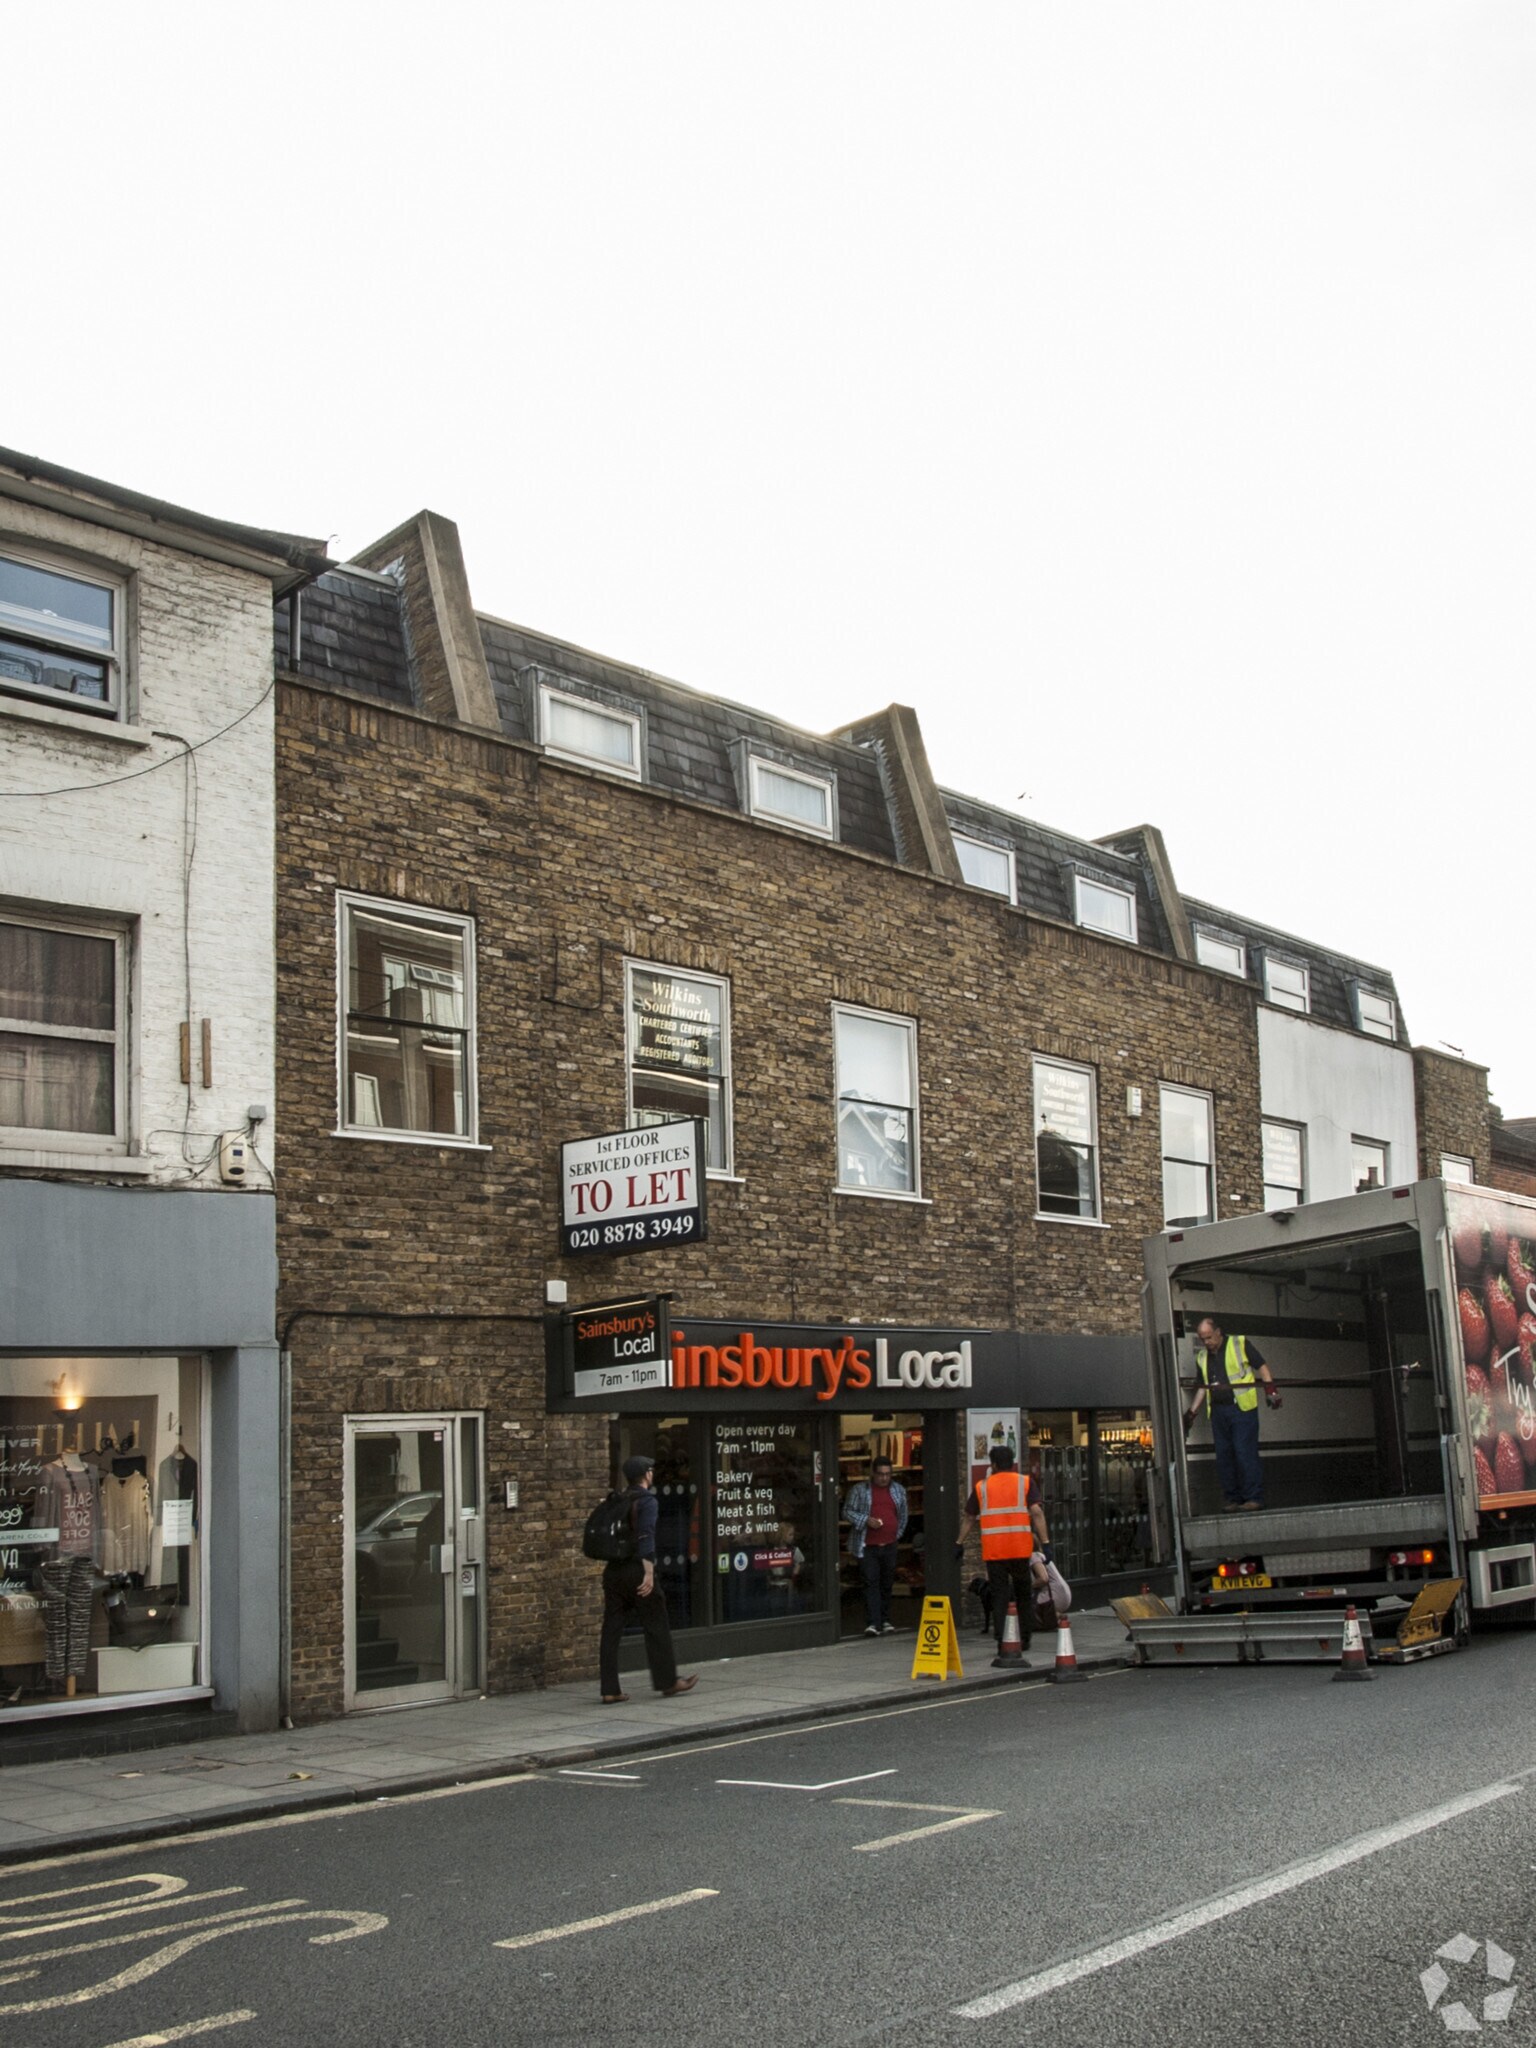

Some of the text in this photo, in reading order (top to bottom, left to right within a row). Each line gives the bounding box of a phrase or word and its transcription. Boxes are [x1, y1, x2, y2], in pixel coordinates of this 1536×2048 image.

[653, 982, 701, 1004] Wilkins
[643, 998, 711, 1023] Southworth
[639, 1016, 677, 1032] CHARTERED
[655, 1034, 700, 1050] ACCOUNTANTS
[640, 1046, 680, 1062] REGISTERED
[597, 1132, 659, 1154] 1st FLOOR
[569, 1146, 690, 1178] SERVICED OFFICES
[571, 1167, 691, 1216] TO LET
[570, 1215, 694, 1248] 020 8878 3949
[578, 1312, 655, 1339] Sainsbury's
[614, 1332, 655, 1357] Local
[672, 1330, 972, 1402] insbury's Local
[600, 1373, 622, 1386] 7am
[631, 1370, 657, 1384] 11pm
[1494, 1346, 1535, 1441] Try
[716, 1424, 796, 1440] Open every day
[716, 1443, 740, 1454] 7am
[750, 1441, 775, 1455] 11pm
[717, 1471, 752, 1484] Bakery
[717, 1487, 773, 1502] Fruit & veg
[717, 1503, 775, 1519] Meat & fish
[717, 1521, 779, 1537] Beer & wine
[754, 1553, 768, 1561] Click
[774, 1551, 792, 1559] Collect
